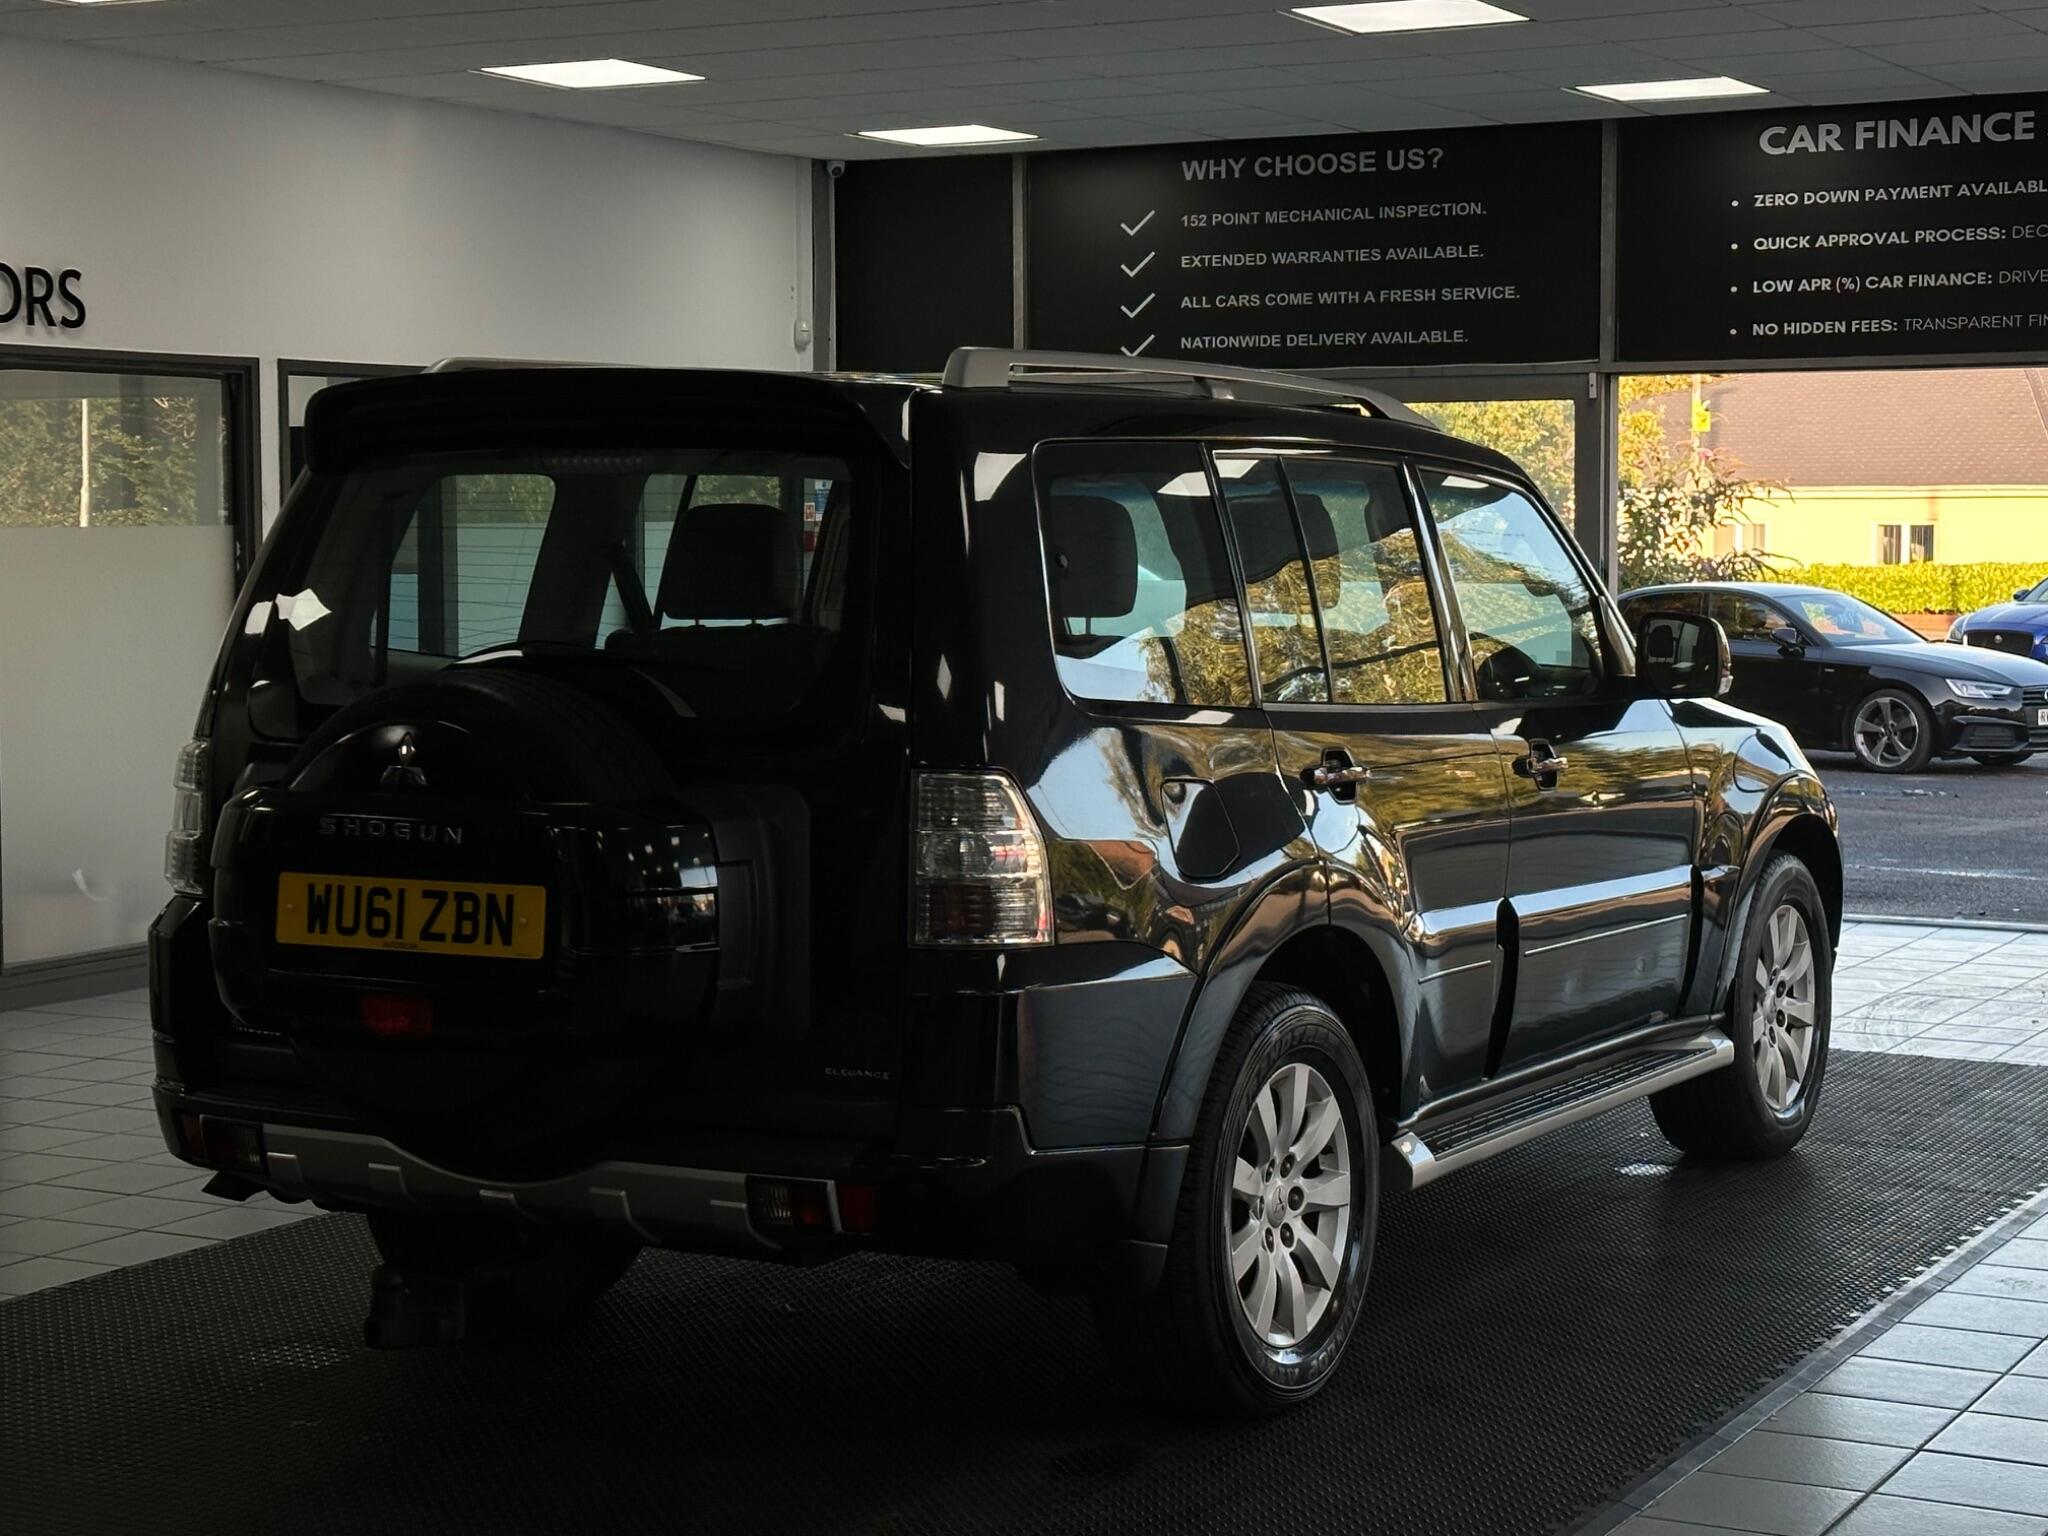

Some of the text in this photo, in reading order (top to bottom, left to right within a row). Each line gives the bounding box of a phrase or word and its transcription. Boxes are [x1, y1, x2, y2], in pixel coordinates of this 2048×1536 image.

[1759, 110, 2035, 155] CAR FINANCE
[1181, 147, 1444, 181] WHY CHOOSE US?
[1754, 193, 1799, 207] ZERO
[1803, 190, 1860, 204] DOWN
[1865, 185, 1953, 201] PAYMENT
[1181, 203, 1487, 227] 152 POINT MECHANICAL INSPECTION.
[1753, 236, 1811, 250] QUICK
[1814, 232, 1910, 248] APPROVAL
[1914, 227, 2007, 243] PROCESS:
[1181, 245, 1484, 267] EXTENDED WARRANTIES AVAILABLE.
[1752, 280, 1794, 293] LOW
[1797, 279, 1832, 292] APR
[1835, 277, 1861, 293] (%)
[1865, 276, 1904, 289] CAR
[1908, 273, 1993, 287] FINANCE:
[1181, 286, 1521, 308] ALL CARS COME WITH A FRESH SERVICE.
[1752, 323, 1779, 335] NO
[1783, 321, 1847, 334] HIDDEN
[1851, 319, 1899, 332] FEES:
[1904, 315, 2024, 331] TRANSPARENT
[1181, 330, 1469, 349] NATIONWIDE DELIVERY AVAILABLE.
[320, 817, 463, 845] SHOGUN
[306, 882, 514, 947] WU61 ZBN
[824, 1066, 890, 1080] ELEGANCE
